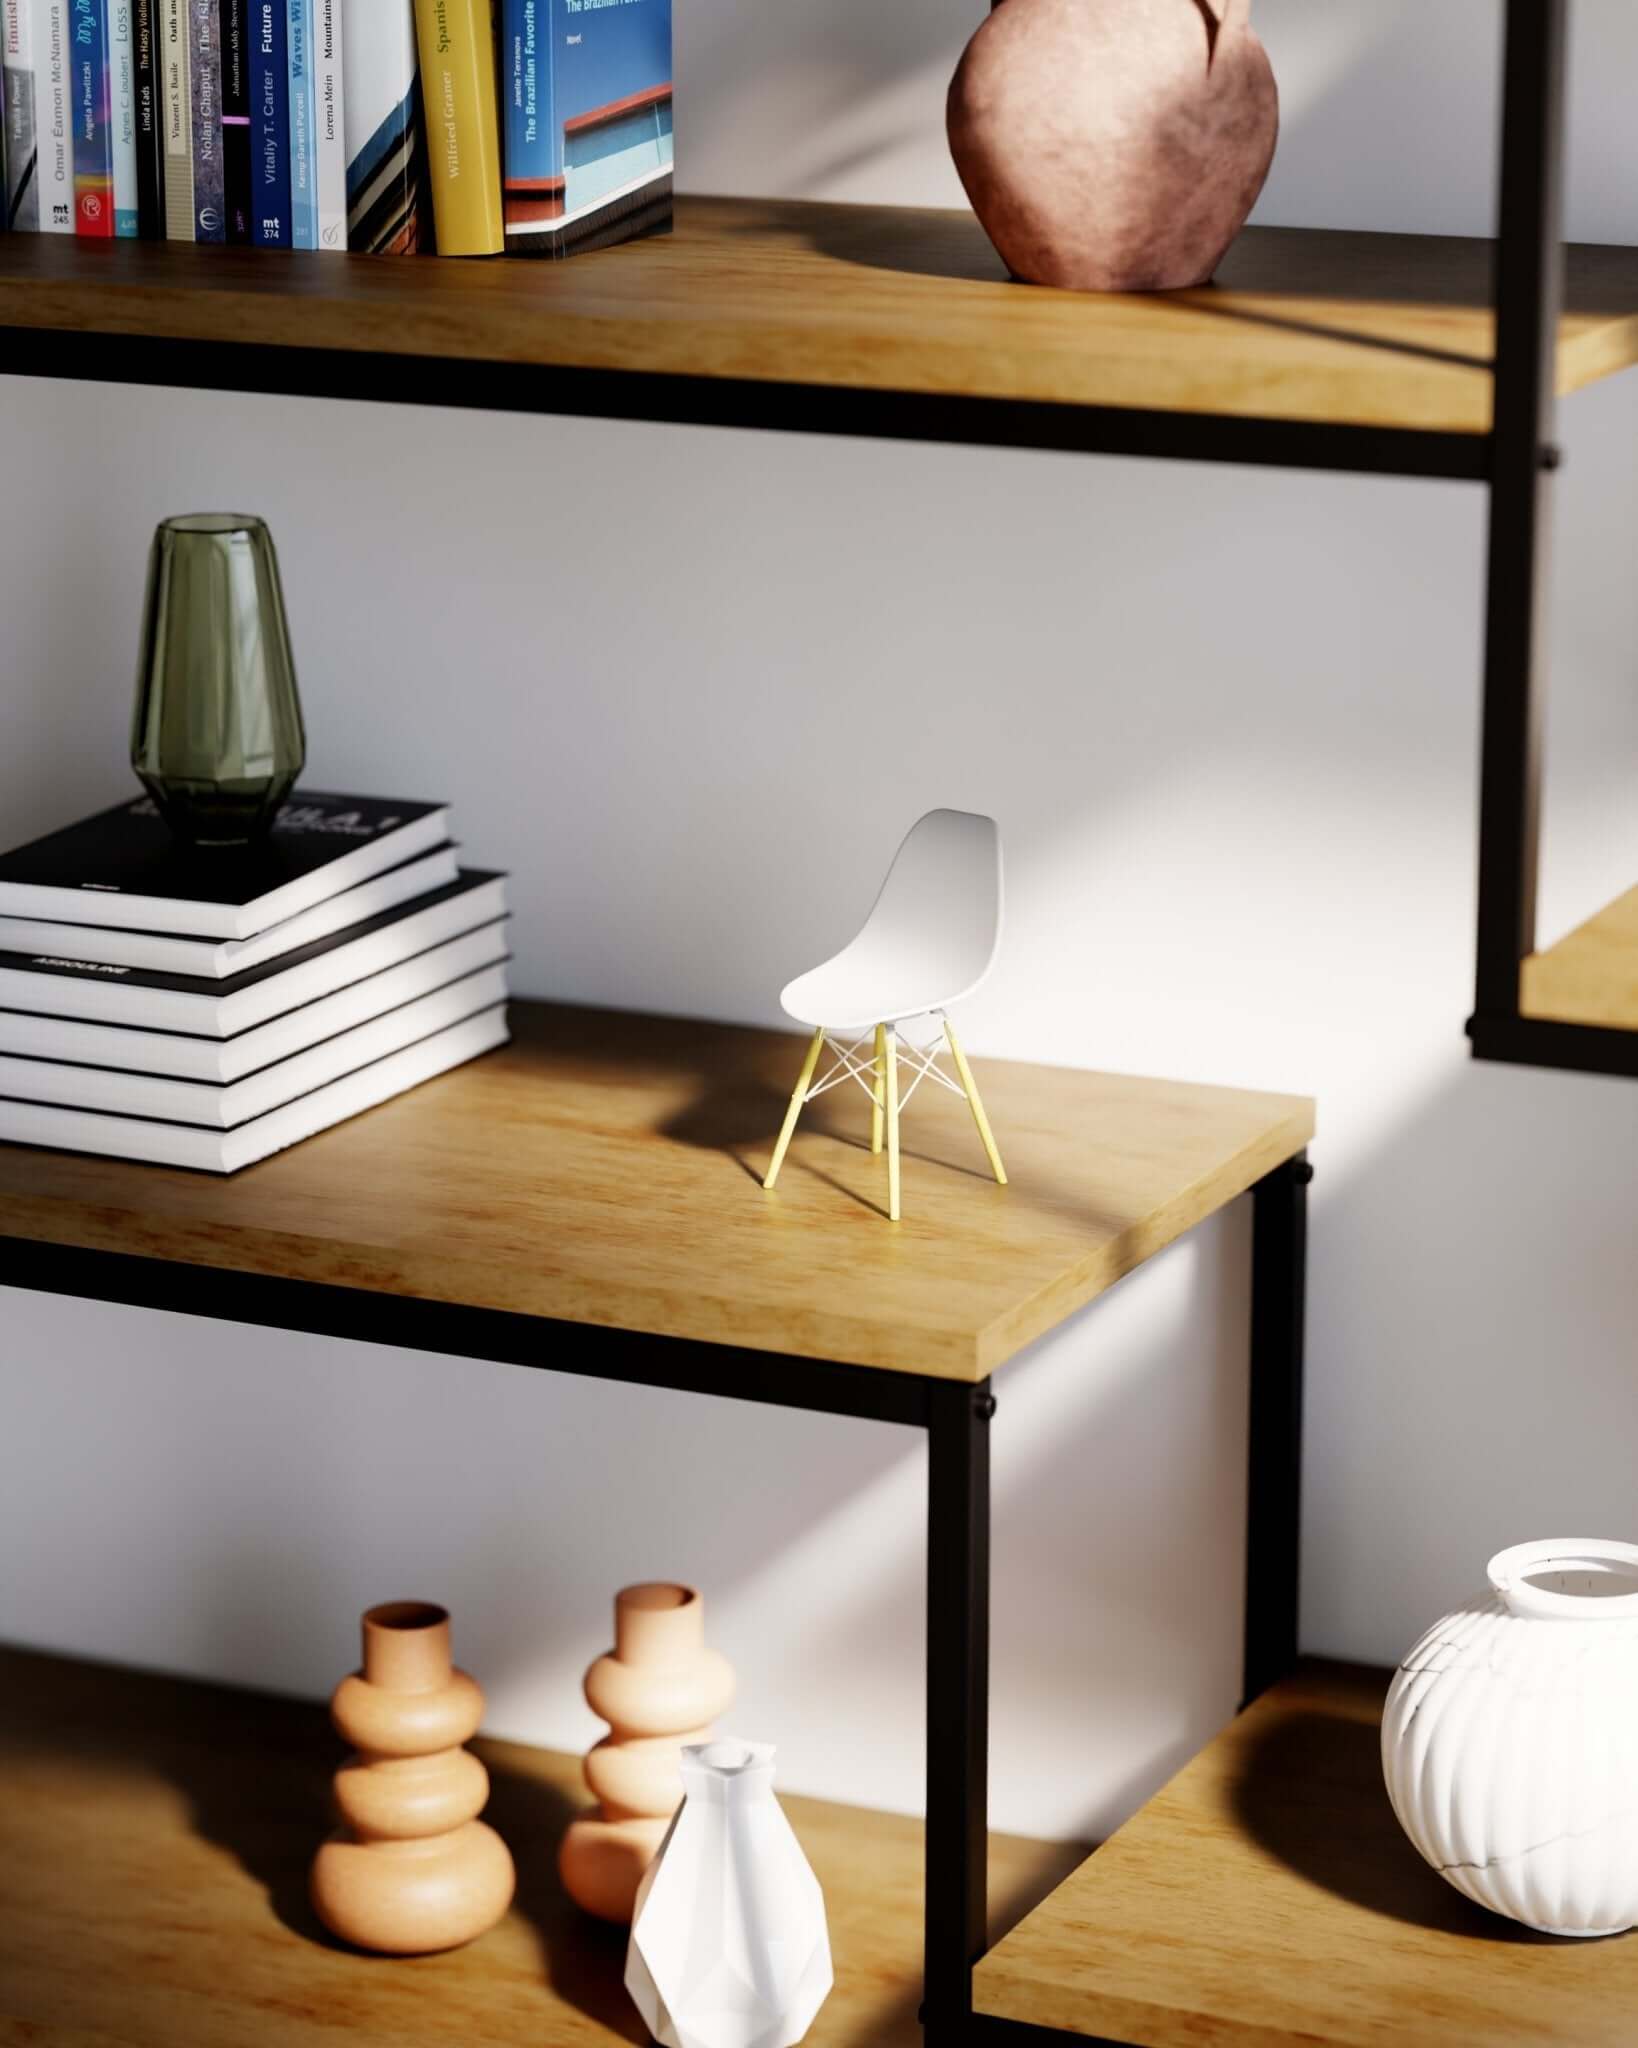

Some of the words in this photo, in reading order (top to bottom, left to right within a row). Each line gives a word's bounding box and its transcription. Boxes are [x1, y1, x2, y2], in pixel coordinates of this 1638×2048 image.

[115, 7, 128, 42] Loss
[567, 0, 582, 14] The
[49, 6, 62, 84] McNamara
[138, 27, 150, 53] Hasty
[169, 17, 178, 43] Oath
[198, 24, 210, 54] The
[230, 29, 241, 52] Addy
[261, 4, 273, 54] Future
[323, 0, 333, 60] Mountains
[433, 1, 451, 54] Spanis
[523, 1, 535, 55] Favorite
[139, 53, 149, 70] The
[291, 27, 304, 79] Waves
[514, 36, 522, 77] Terranova
[119, 55, 130, 95] Joubert
[199, 66, 213, 117] Chaput
[231, 52, 241, 97] Johnathan
[324, 75, 334, 102] Mein
[515, 78, 523, 107] Janelle
[524, 57, 536, 115] Brazilian
[140, 85, 151, 106] Eads
[263, 69, 275, 117] Carter
[442, 70, 455, 118] Graner
[51, 87, 64, 138] Éamon
[85, 107, 96, 141] Angela
[120, 111, 132, 145] Agnes
[141, 107, 152, 132] Linda
[264, 120, 275, 135] T.
[325, 104, 334, 141] Lorena
[525, 117, 536, 143] The
[201, 120, 213, 161] Nolan
[296, 128, 306, 160] Gareth
[445, 121, 460, 179] Wilfried
[53, 142, 65, 182] Omar
[264, 138, 278, 185] Vitaliy
[53, 203, 69, 214] mt
[263, 218, 279, 229] mt
[263, 229, 279, 240] 374
